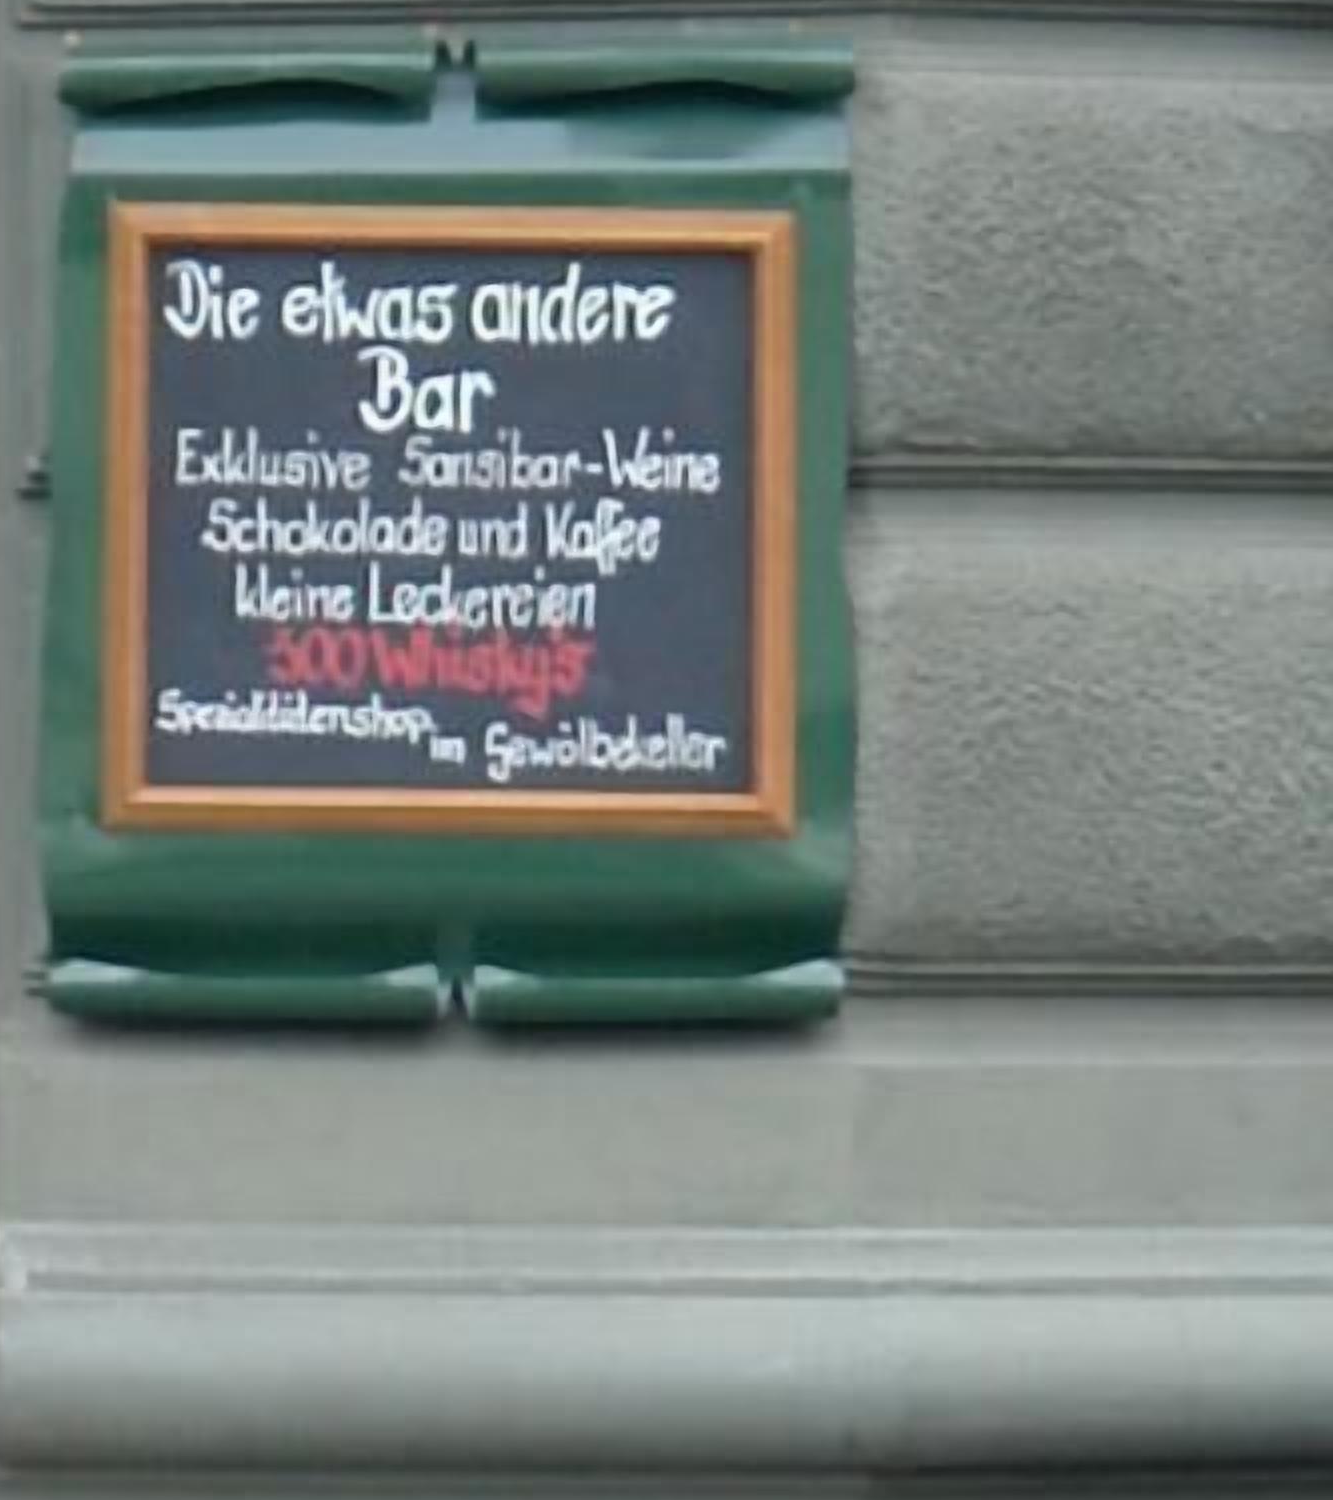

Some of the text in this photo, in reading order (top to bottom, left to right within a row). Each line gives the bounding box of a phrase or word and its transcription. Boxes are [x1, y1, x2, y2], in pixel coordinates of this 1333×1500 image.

[163, 259, 676, 344] Die etwas andere
[357, 345, 496, 433] Bar
[174, 428, 371, 490] Exklusive
[200, 497, 663, 577] Schokolade und Kaffee
[234, 562, 596, 630] kleine Leckereien
